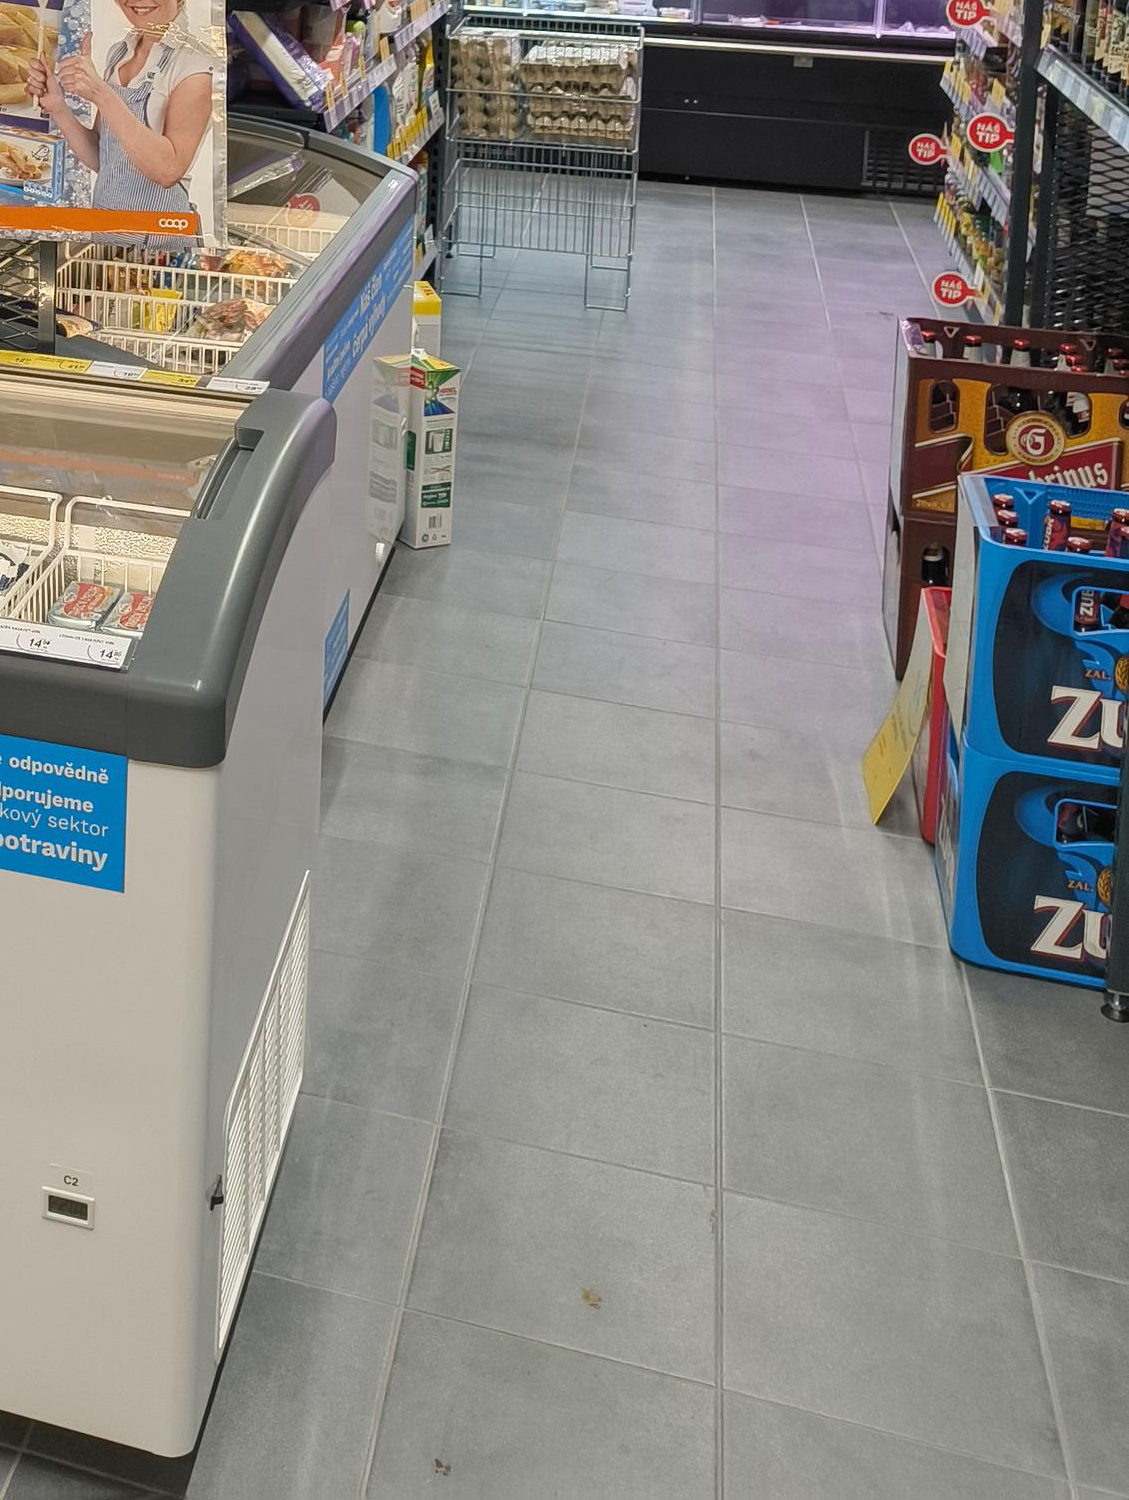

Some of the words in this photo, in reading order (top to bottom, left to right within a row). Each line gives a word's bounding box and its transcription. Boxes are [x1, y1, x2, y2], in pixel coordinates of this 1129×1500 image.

[955, 1, 978, 11] NÁŠ
[955, 10, 977, 20] TIP
[976, 122, 1001, 134] NÁŠ
[976, 132, 1000, 144] TIP
[916, 150, 935, 159] TIP
[940, 289, 961, 300] TIP
[9, 754, 110, 785] odpovědně
[47, 814, 109, 838] sektor
[63, 1174, 80, 1187] C2
